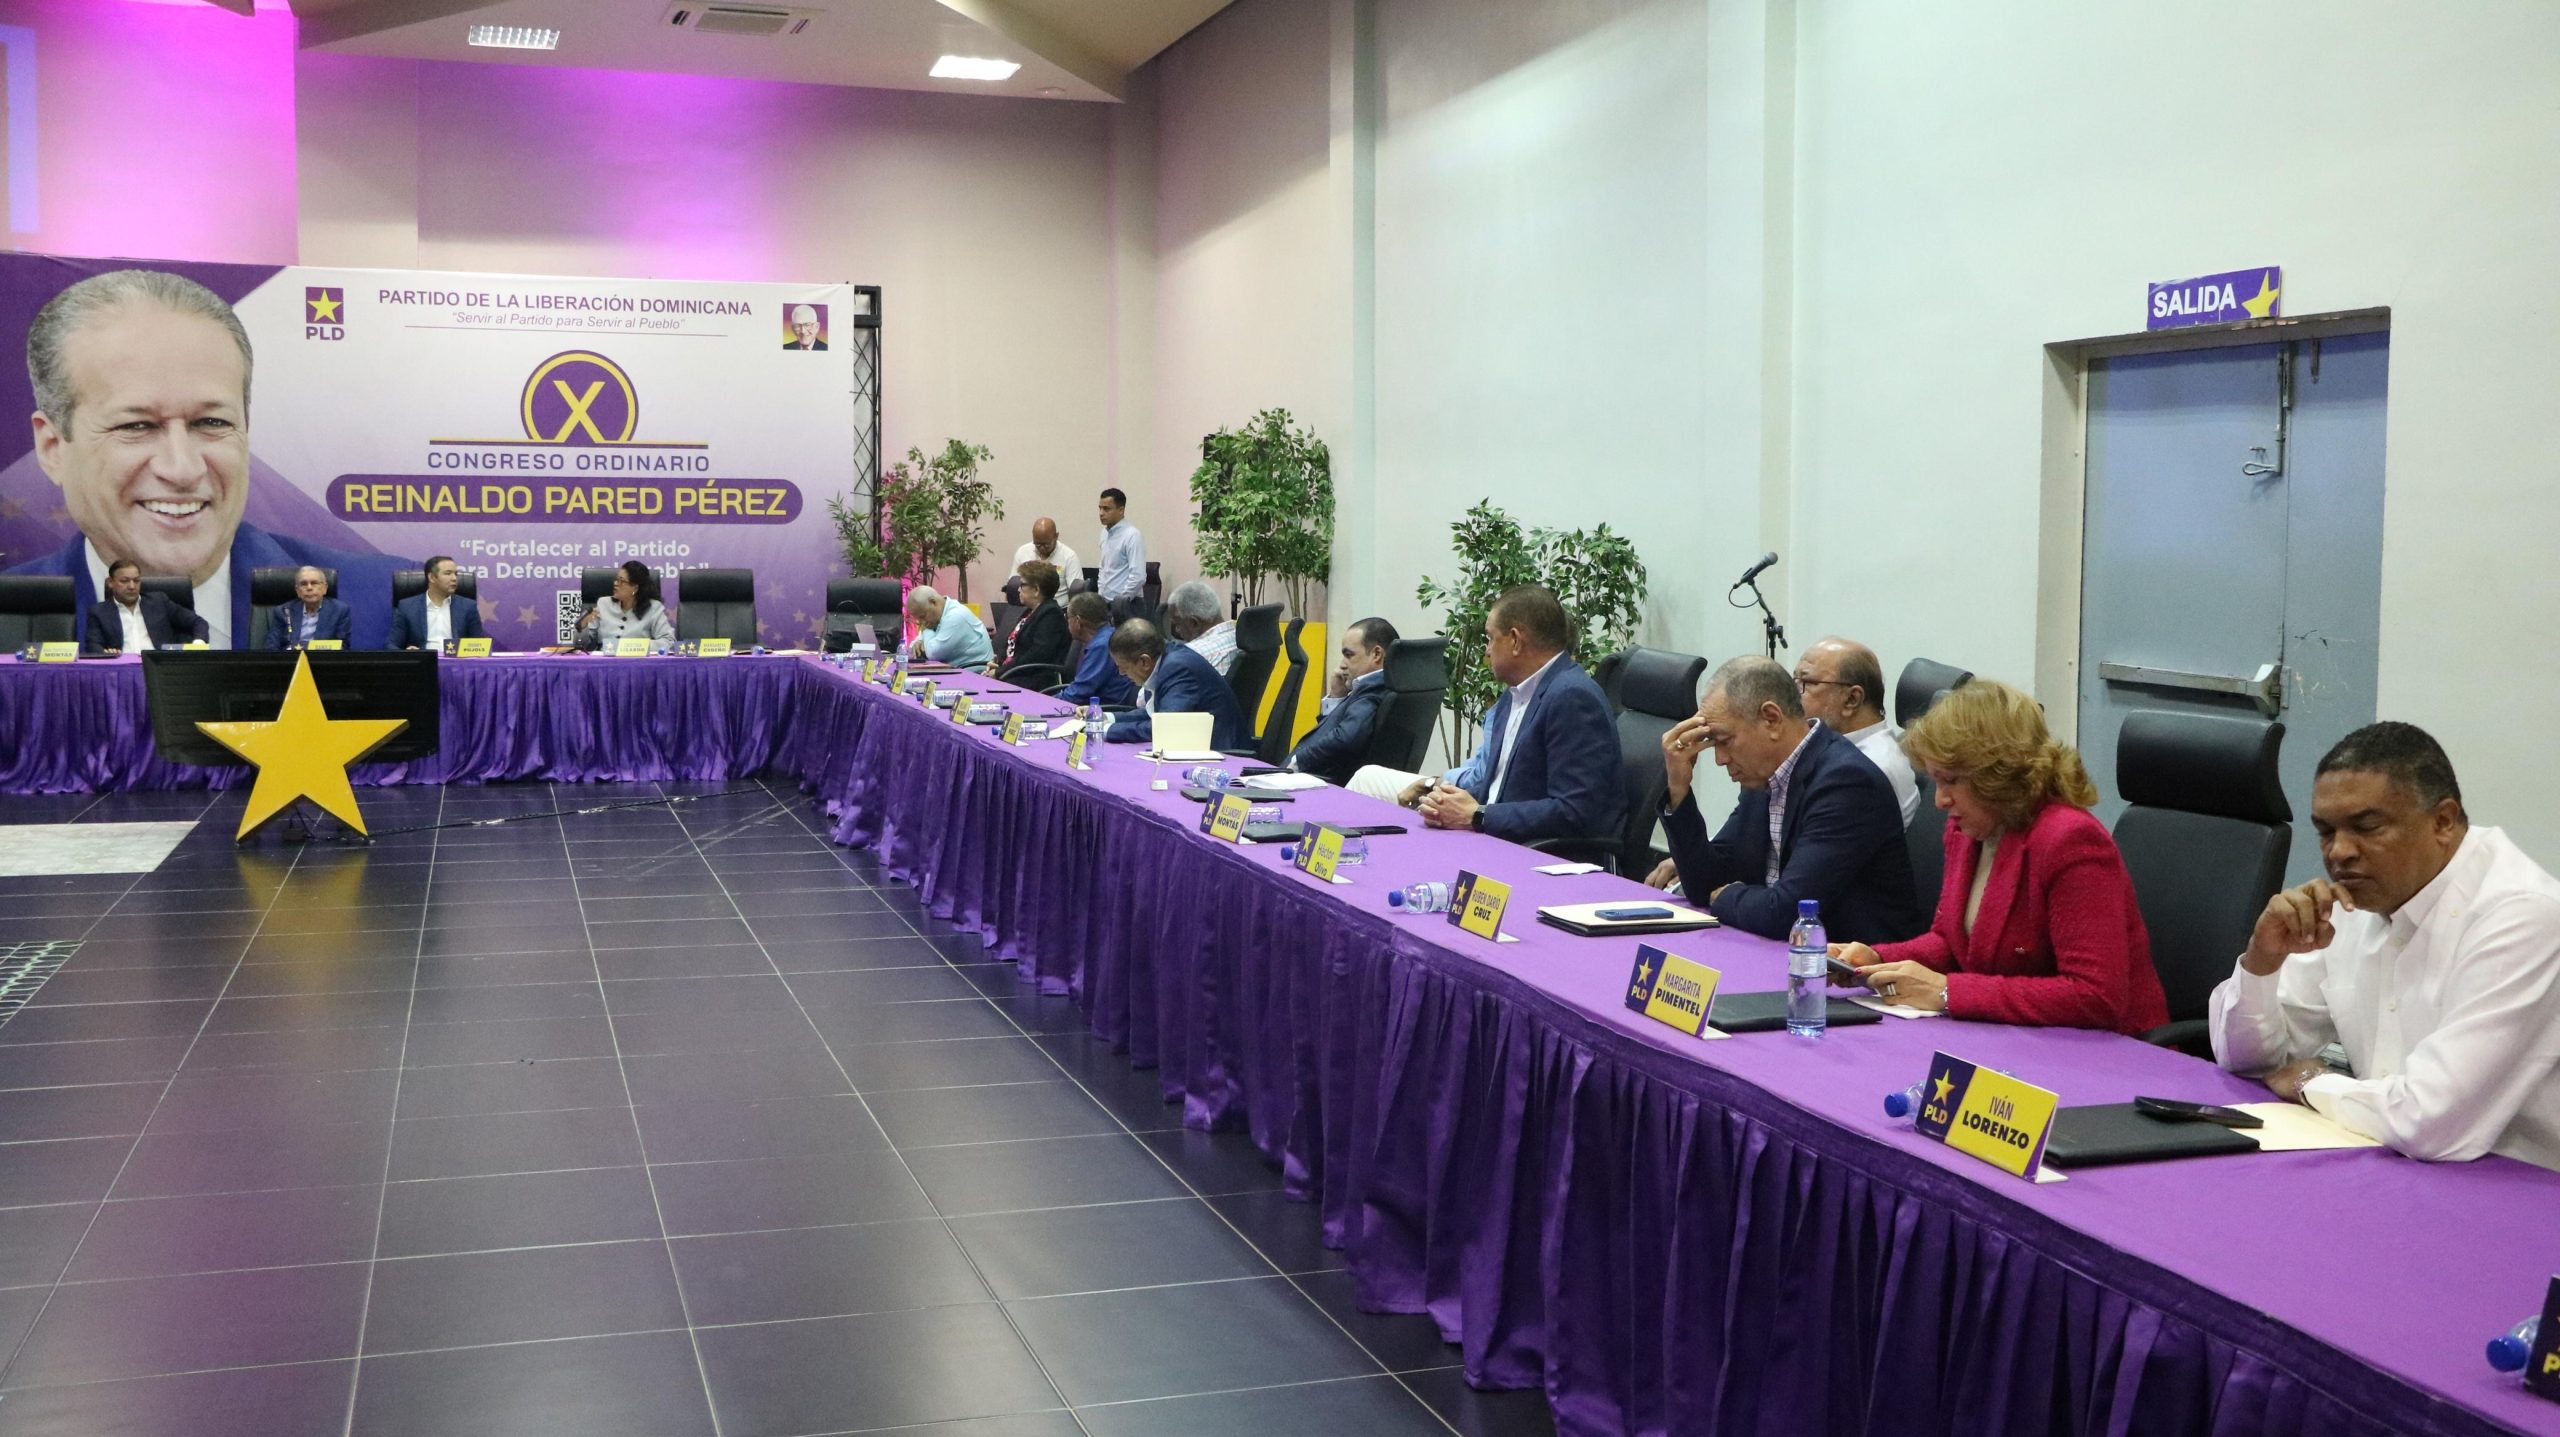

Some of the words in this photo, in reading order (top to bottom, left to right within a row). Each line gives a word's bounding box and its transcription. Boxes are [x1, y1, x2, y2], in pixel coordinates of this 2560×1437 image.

[379, 289, 460, 306] PARTIDO
[466, 293, 490, 307] DE
[496, 294, 520, 308] LA
[525, 294, 634, 312] LIBERACIÓN
[640, 298, 752, 315] DOMINICANA
[2153, 283, 2236, 318] SALIDA
[495, 313, 506, 325] al
[511, 313, 553, 327] Partido
[556, 317, 583, 330] para
[587, 316, 621, 329] Servir
[625, 317, 635, 329] al
[305, 327, 344, 341] PLD
[552, 380, 606, 442] X
[427, 452, 565, 471] CONGRESO
[576, 454, 711, 472] ORDINARIO
[344, 483, 533, 514] REINALDO
[545, 486, 663, 516] PARED
[675, 479, 787, 517] PÉREZ
[589, 539, 607, 556] al
[614, 539, 691, 557] Partido
[496, 561, 594, 579] Defende
[1203, 816, 1212, 826] PLD
[1216, 814, 1239, 831] MONTÁS
[1296, 854, 1308, 867] PLD
[1314, 861, 1328, 877] Olivo
[1451, 903, 1463, 915] PLD
[1473, 906, 1492, 921] CRUZ
[1631, 984, 1648, 1001] PLD
[1663, 971, 1702, 1000] MARGARITA
[1655, 987, 1700, 1017] PIMENTEL
[1924, 1103, 1948, 1125] PLD
[1988, 1095, 2015, 1122] IVÁN
[1962, 1110, 2030, 1150] LORENZO
